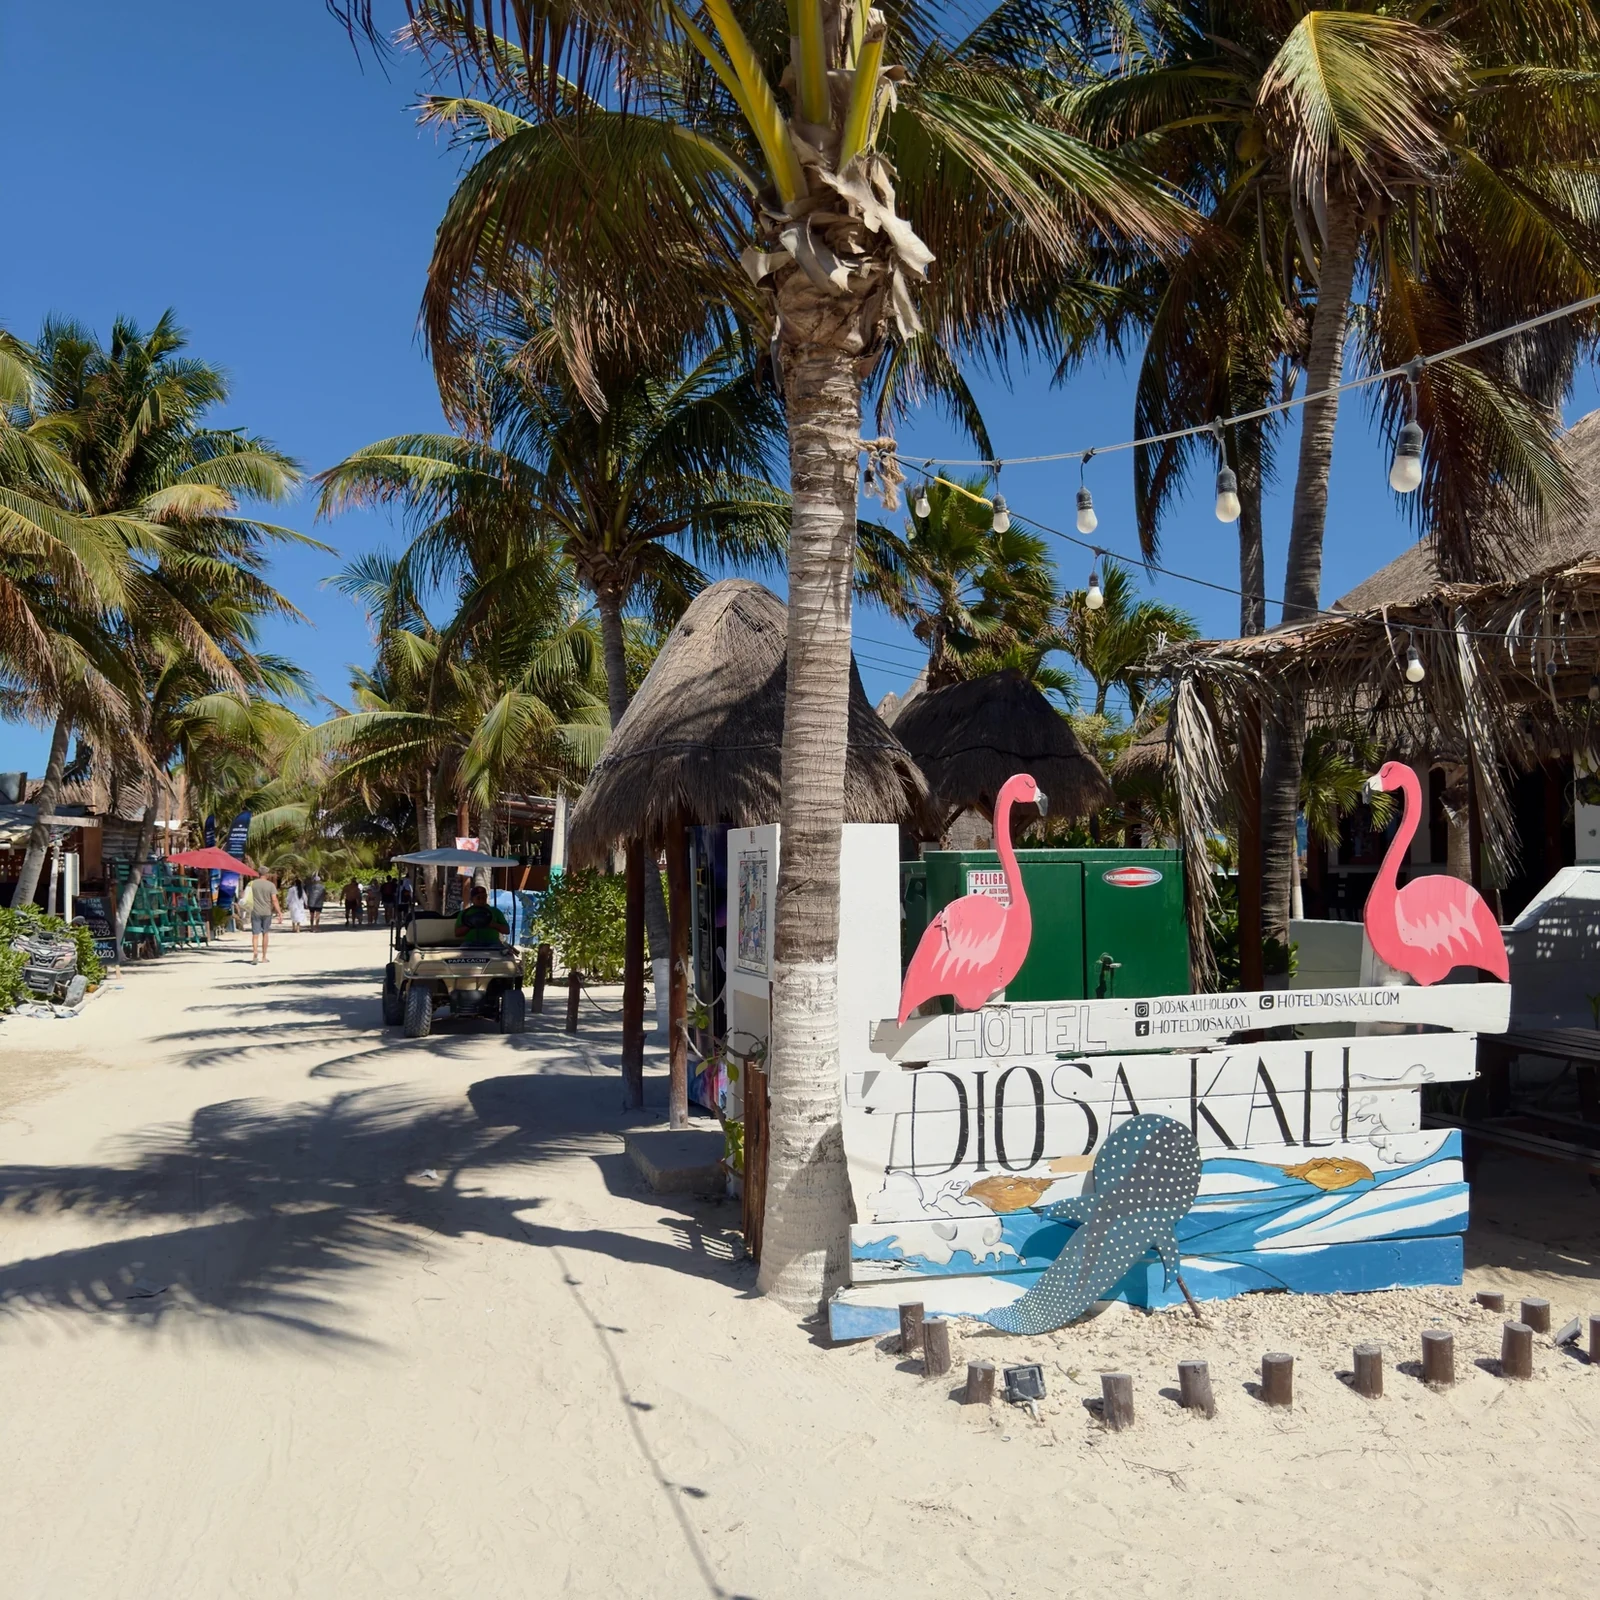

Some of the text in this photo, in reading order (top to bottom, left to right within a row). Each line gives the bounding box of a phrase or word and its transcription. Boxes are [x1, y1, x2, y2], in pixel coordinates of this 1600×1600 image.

[947, 1004, 1108, 1059] HOTEL
[1152, 1014, 1252, 1035] HOTELDIOSAKALI
[909, 1046, 1350, 1178] DIOSA KALI
